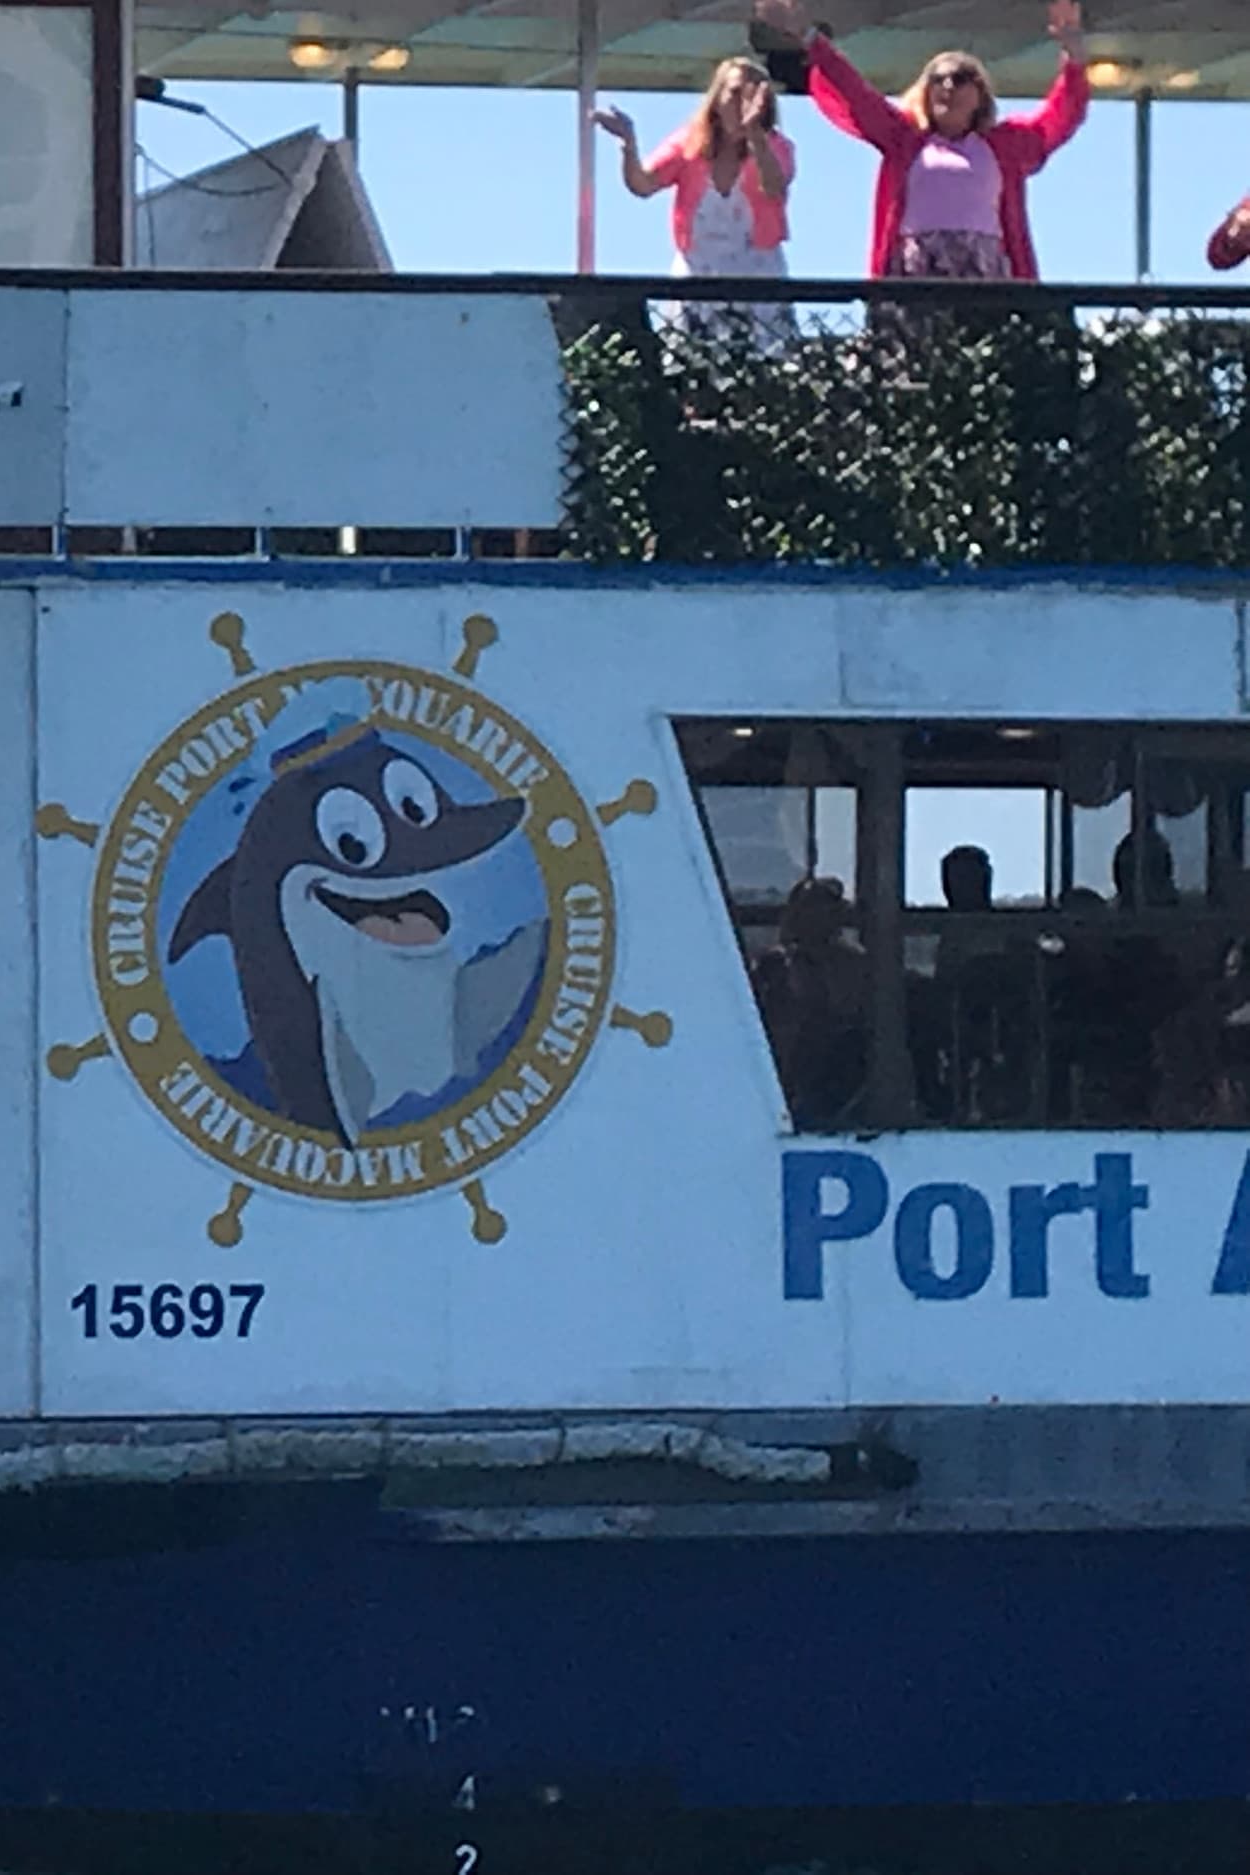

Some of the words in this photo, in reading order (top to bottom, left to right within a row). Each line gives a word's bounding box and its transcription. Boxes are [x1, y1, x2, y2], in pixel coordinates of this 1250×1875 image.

[108, 800, 173, 986] CRUISE
[155, 696, 266, 805] PORT
[543, 883, 607, 1065] CRUISE
[159, 1061, 426, 1188] MACQUARIE
[440, 1063, 553, 1167] PORT
[782, 1149, 1151, 1301] Port
[71, 1283, 265, 1338] 15697
